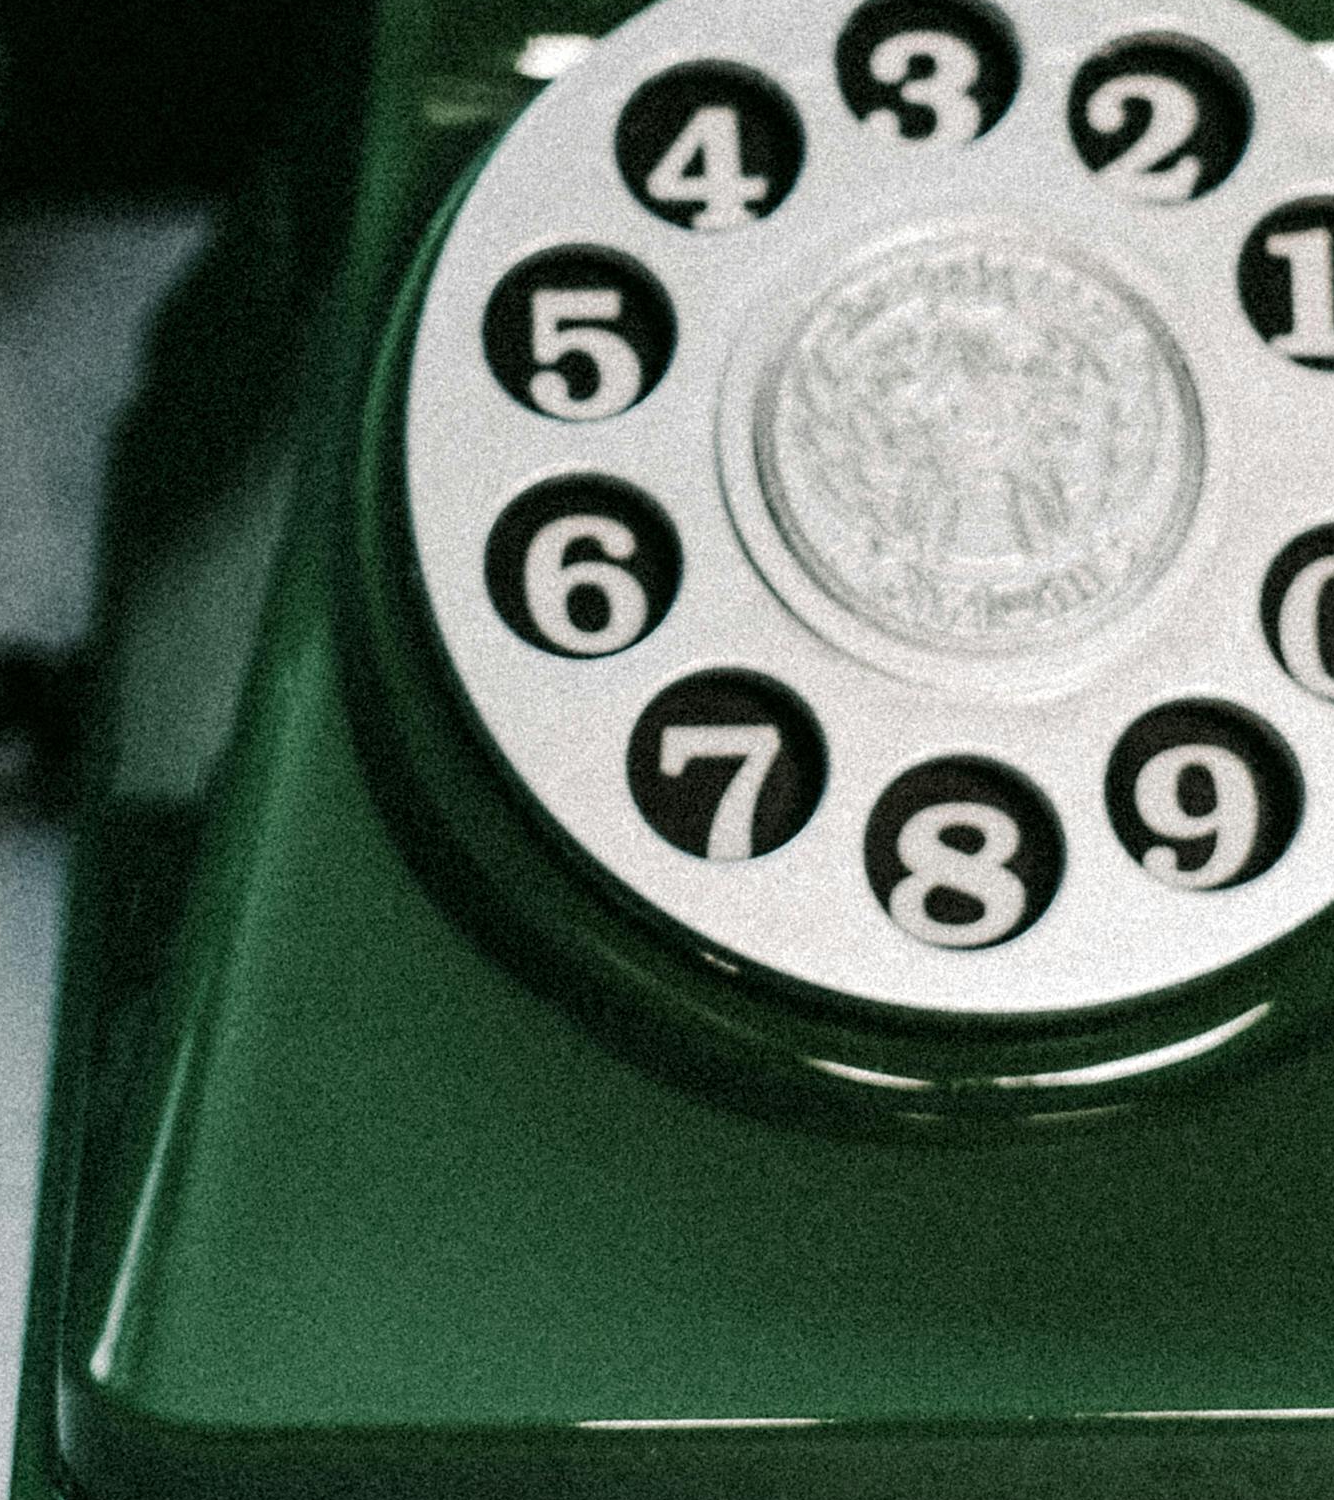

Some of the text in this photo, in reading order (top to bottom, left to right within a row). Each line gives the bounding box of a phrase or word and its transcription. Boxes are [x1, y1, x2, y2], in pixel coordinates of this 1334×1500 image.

[868, 30, 982, 145] 3
[1084, 74, 1201, 202] 2
[646, 103, 767, 231] 4
[528, 289, 644, 420] 5
[523, 514, 648, 656] 6
[660, 723, 781, 861] 7
[1135, 744, 1260, 887] 9
[887, 800, 1028, 949] 8
